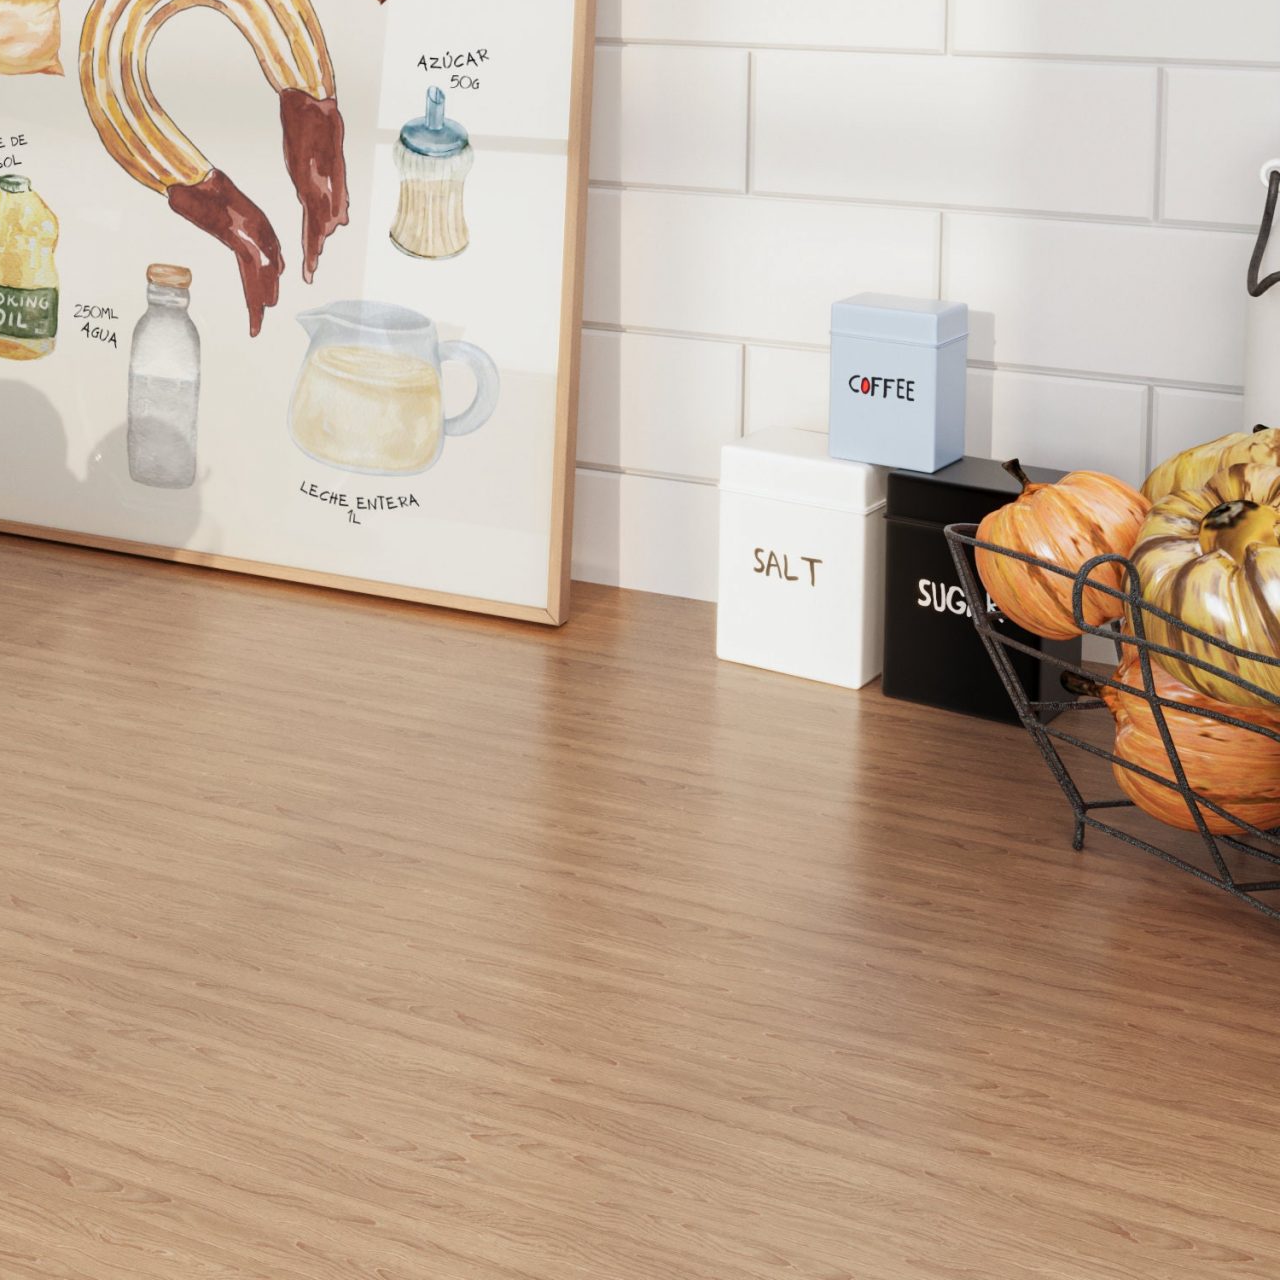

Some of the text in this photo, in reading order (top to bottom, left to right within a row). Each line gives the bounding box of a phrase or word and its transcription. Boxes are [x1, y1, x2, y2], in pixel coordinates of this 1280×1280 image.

[416, 48, 491, 72] AZÚCAR
[449, 74, 480, 90] 50G
[10, 133, 29, 147] DE
[73, 303, 120, 320] 250ML
[80, 321, 118, 349] AGUA
[848, 374, 916, 402] COFFEE
[299, 480, 421, 511] LECHE ENTERA
[347, 508, 362, 525] 1L
[752, 547, 824, 587] SALT
